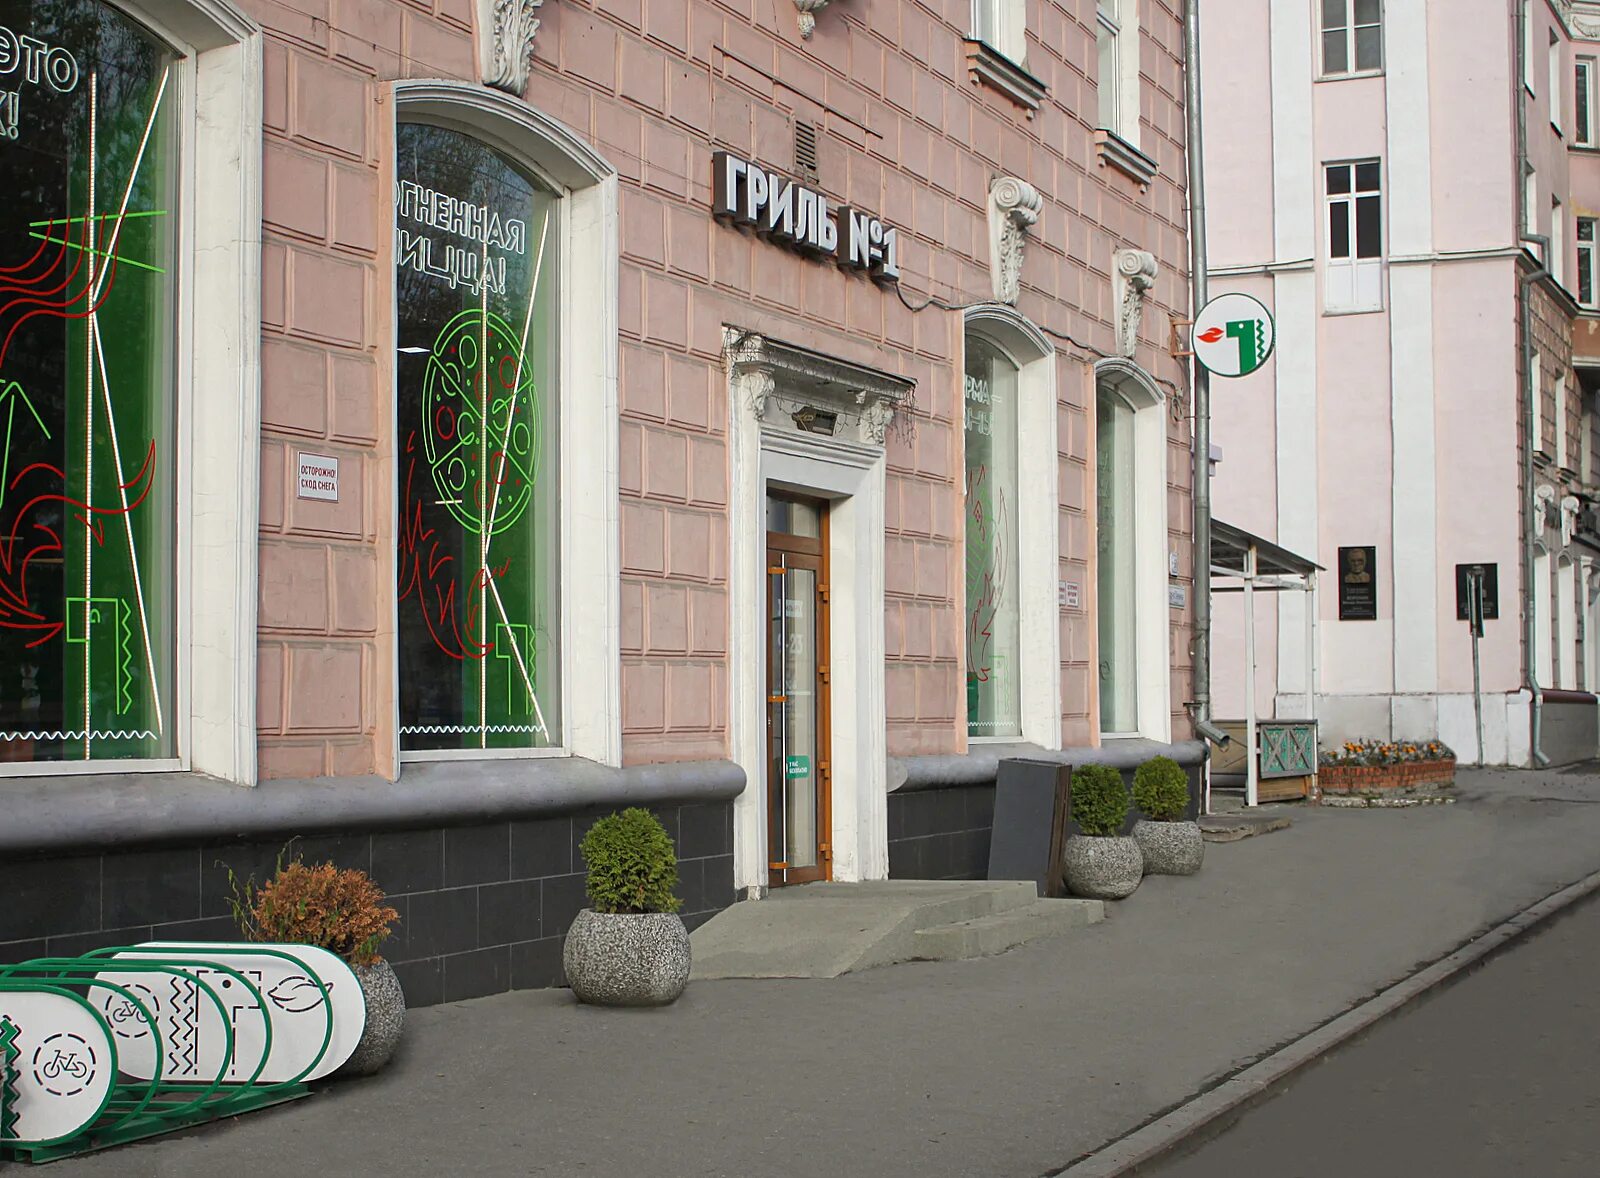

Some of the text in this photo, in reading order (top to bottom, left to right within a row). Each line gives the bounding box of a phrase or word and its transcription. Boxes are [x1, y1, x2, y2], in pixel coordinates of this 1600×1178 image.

[396, 179, 525, 255] ГНЕННАЯ
[726, 154, 838, 252] ГРИЛЬ
[396, 227, 506, 296] ИЦЦА!
[301, 478, 336, 492] СХОД СНЕГА
